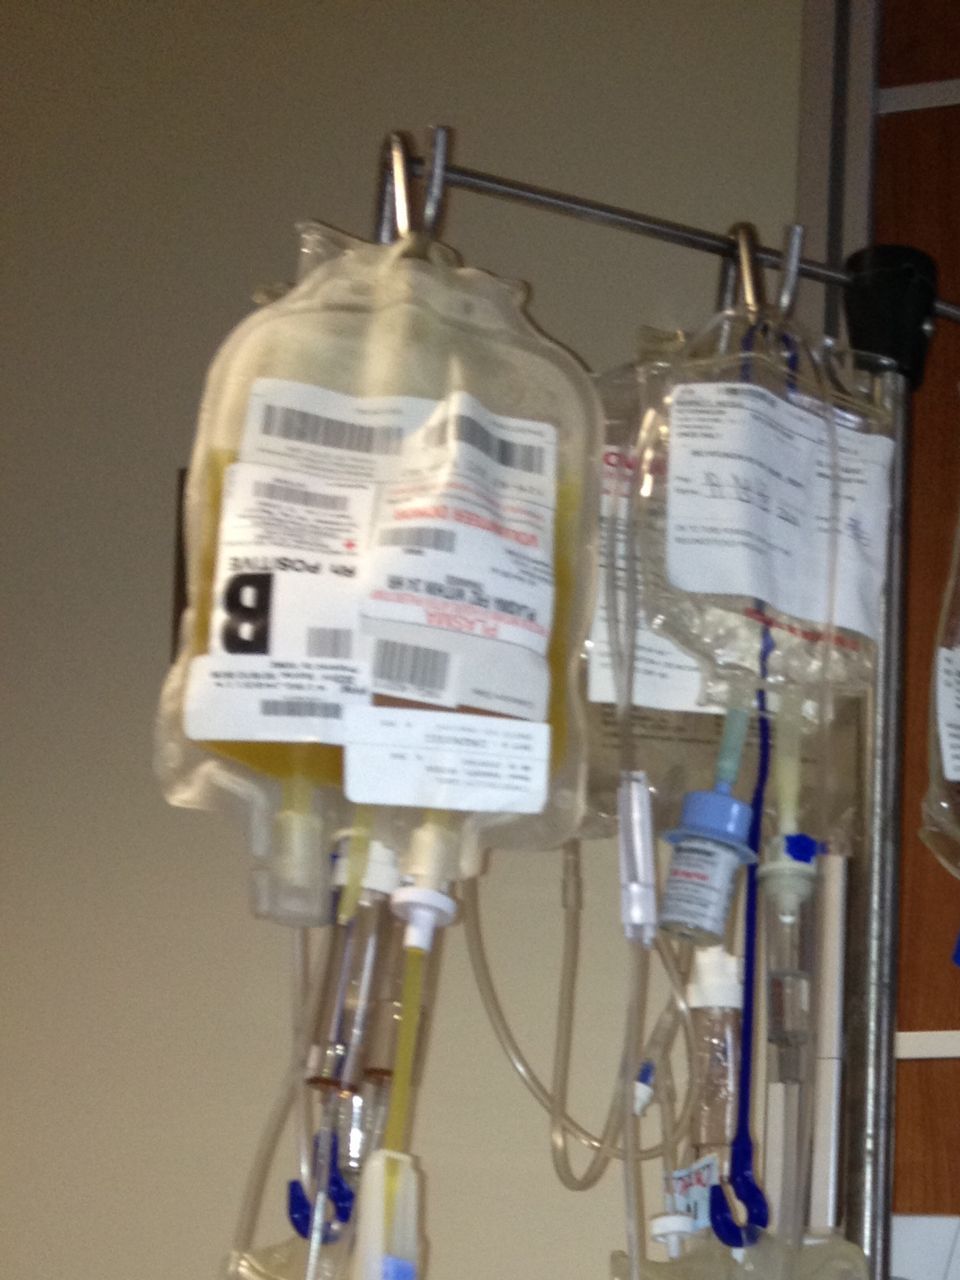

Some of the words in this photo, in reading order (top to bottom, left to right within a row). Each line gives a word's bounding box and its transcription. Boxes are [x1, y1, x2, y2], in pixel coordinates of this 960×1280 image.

[228, 557, 322, 575] POSITIVE
[221, 571, 274, 656] B
[425, 611, 499, 639] PLASMA
